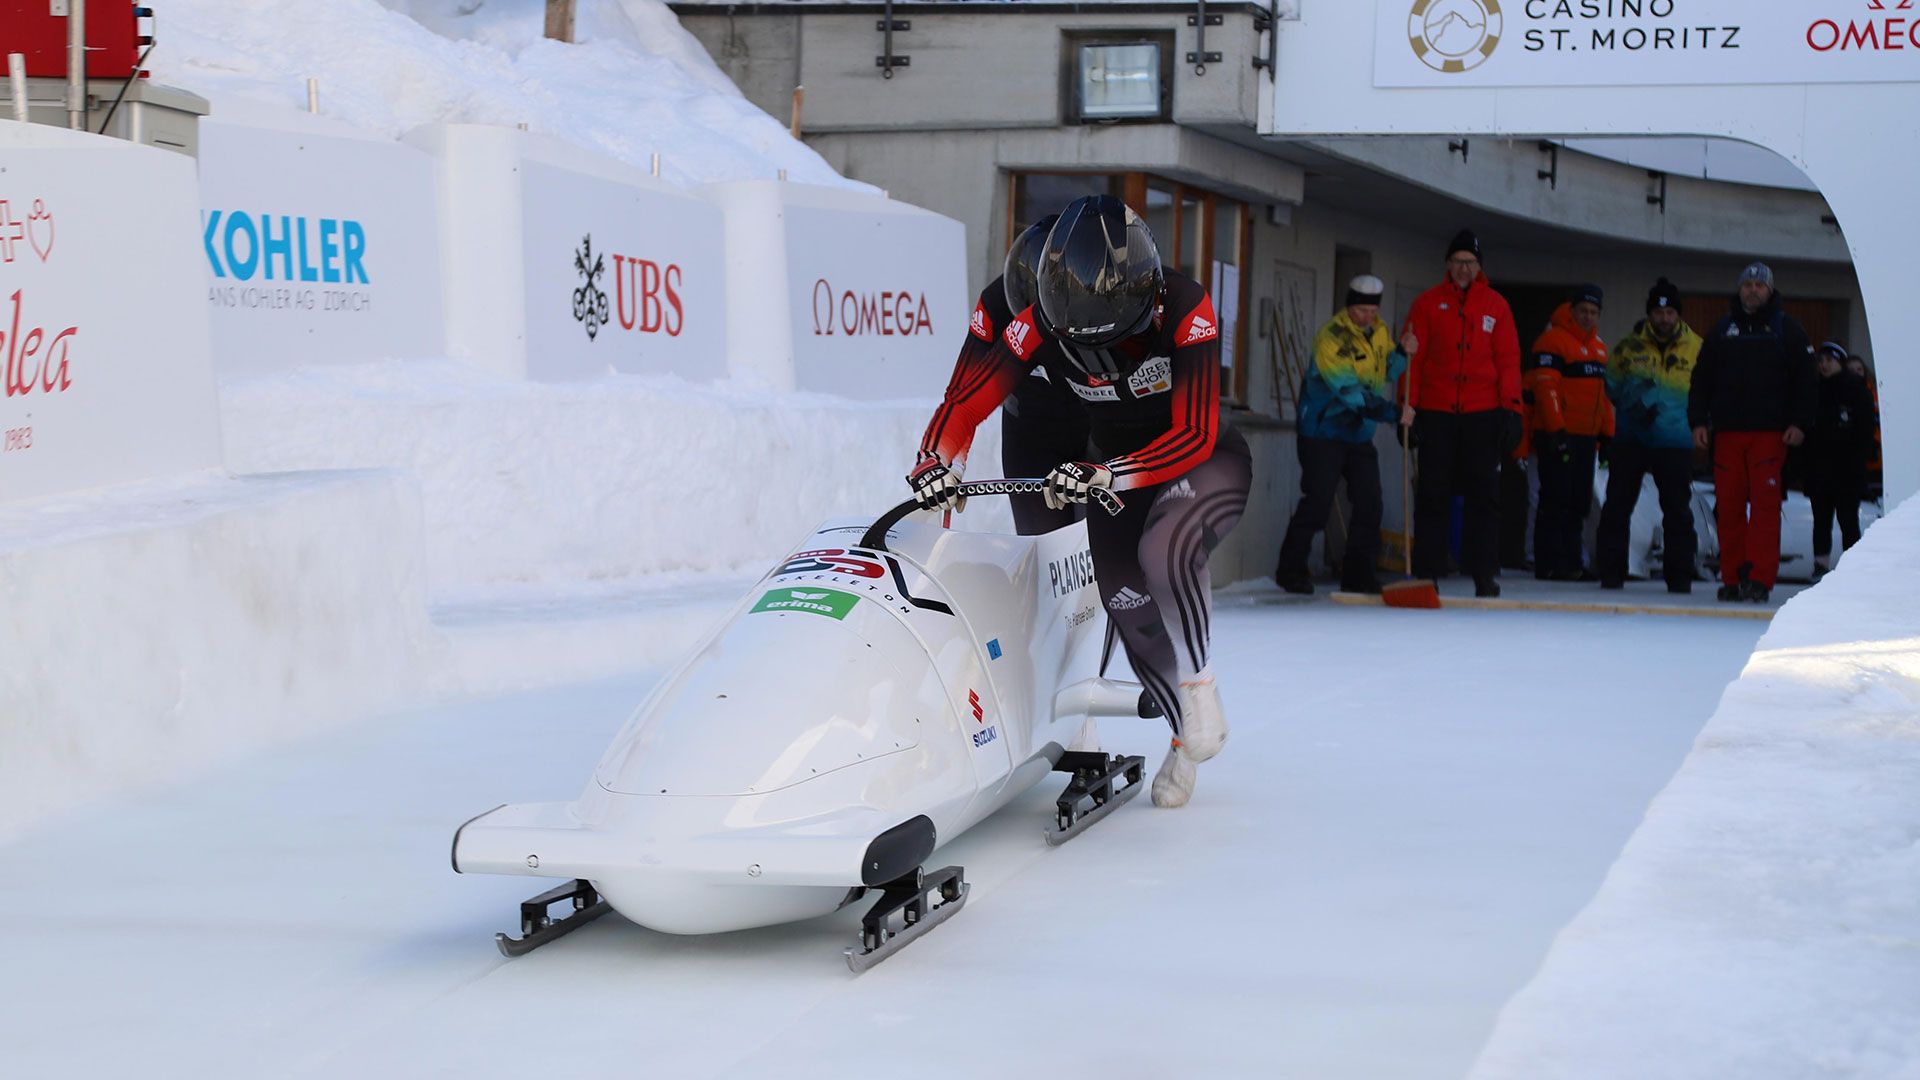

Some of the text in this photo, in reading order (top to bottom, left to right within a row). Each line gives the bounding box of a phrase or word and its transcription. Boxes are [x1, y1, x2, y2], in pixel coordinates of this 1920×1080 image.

[1524, 0, 1674, 19] CASINO
[1524, 26, 1741, 51] ST. MORITZ
[202, 210, 370, 284] KOHLER
[208, 287, 236, 308] ANS
[239, 287, 292, 310] KOHLER
[295, 289, 315, 311] AG
[612, 253, 684, 337] UBS
[840, 289, 934, 337] OMEGA
[0, 288, 79, 397] lea
[918, 468, 944, 487] SEIZ
[1049, 549, 1097, 598] PLANSE
[766, 600, 834, 612] erima
[777, 574, 911, 615] SKELETON
[1109, 594, 1151, 610] adidas
[973, 725, 997, 748] SUZUKI
